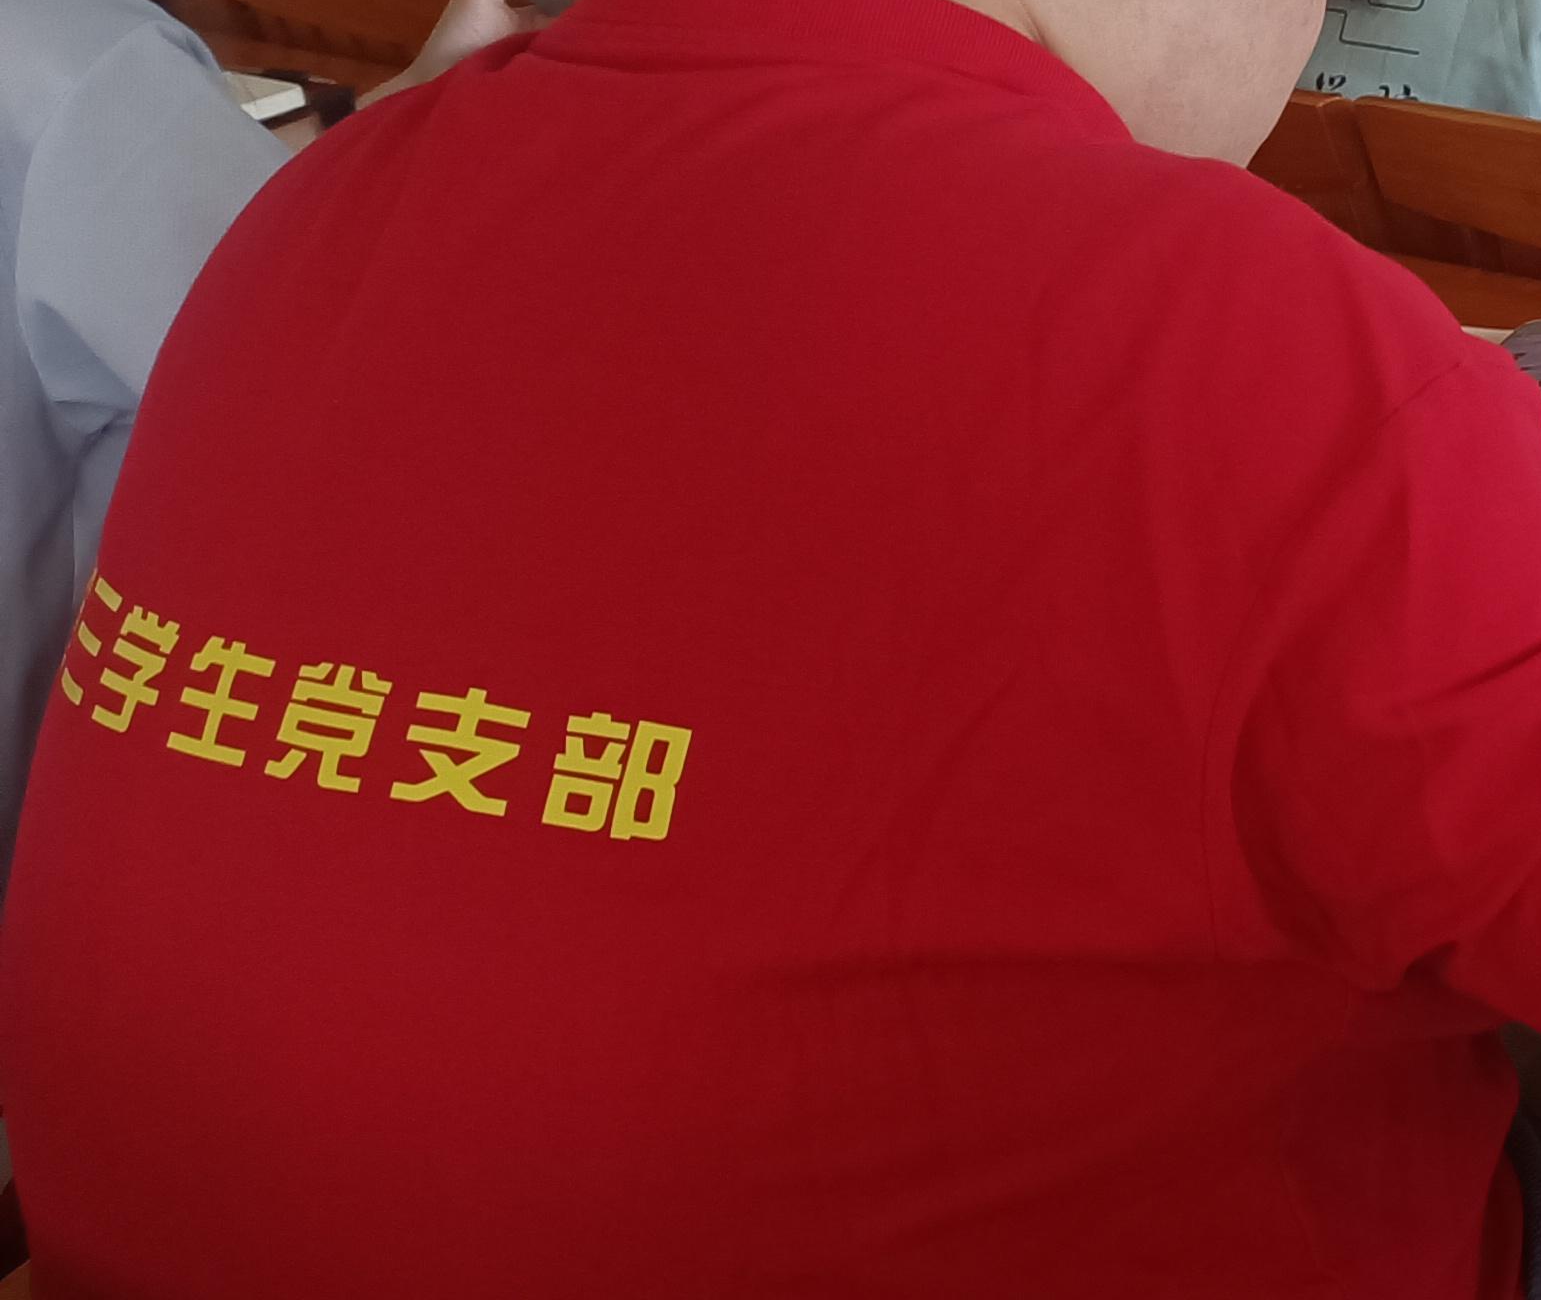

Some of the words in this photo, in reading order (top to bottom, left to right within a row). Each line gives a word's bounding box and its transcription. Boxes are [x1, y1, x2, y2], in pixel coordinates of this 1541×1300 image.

[60, 567, 692, 841] 三学生党支部
